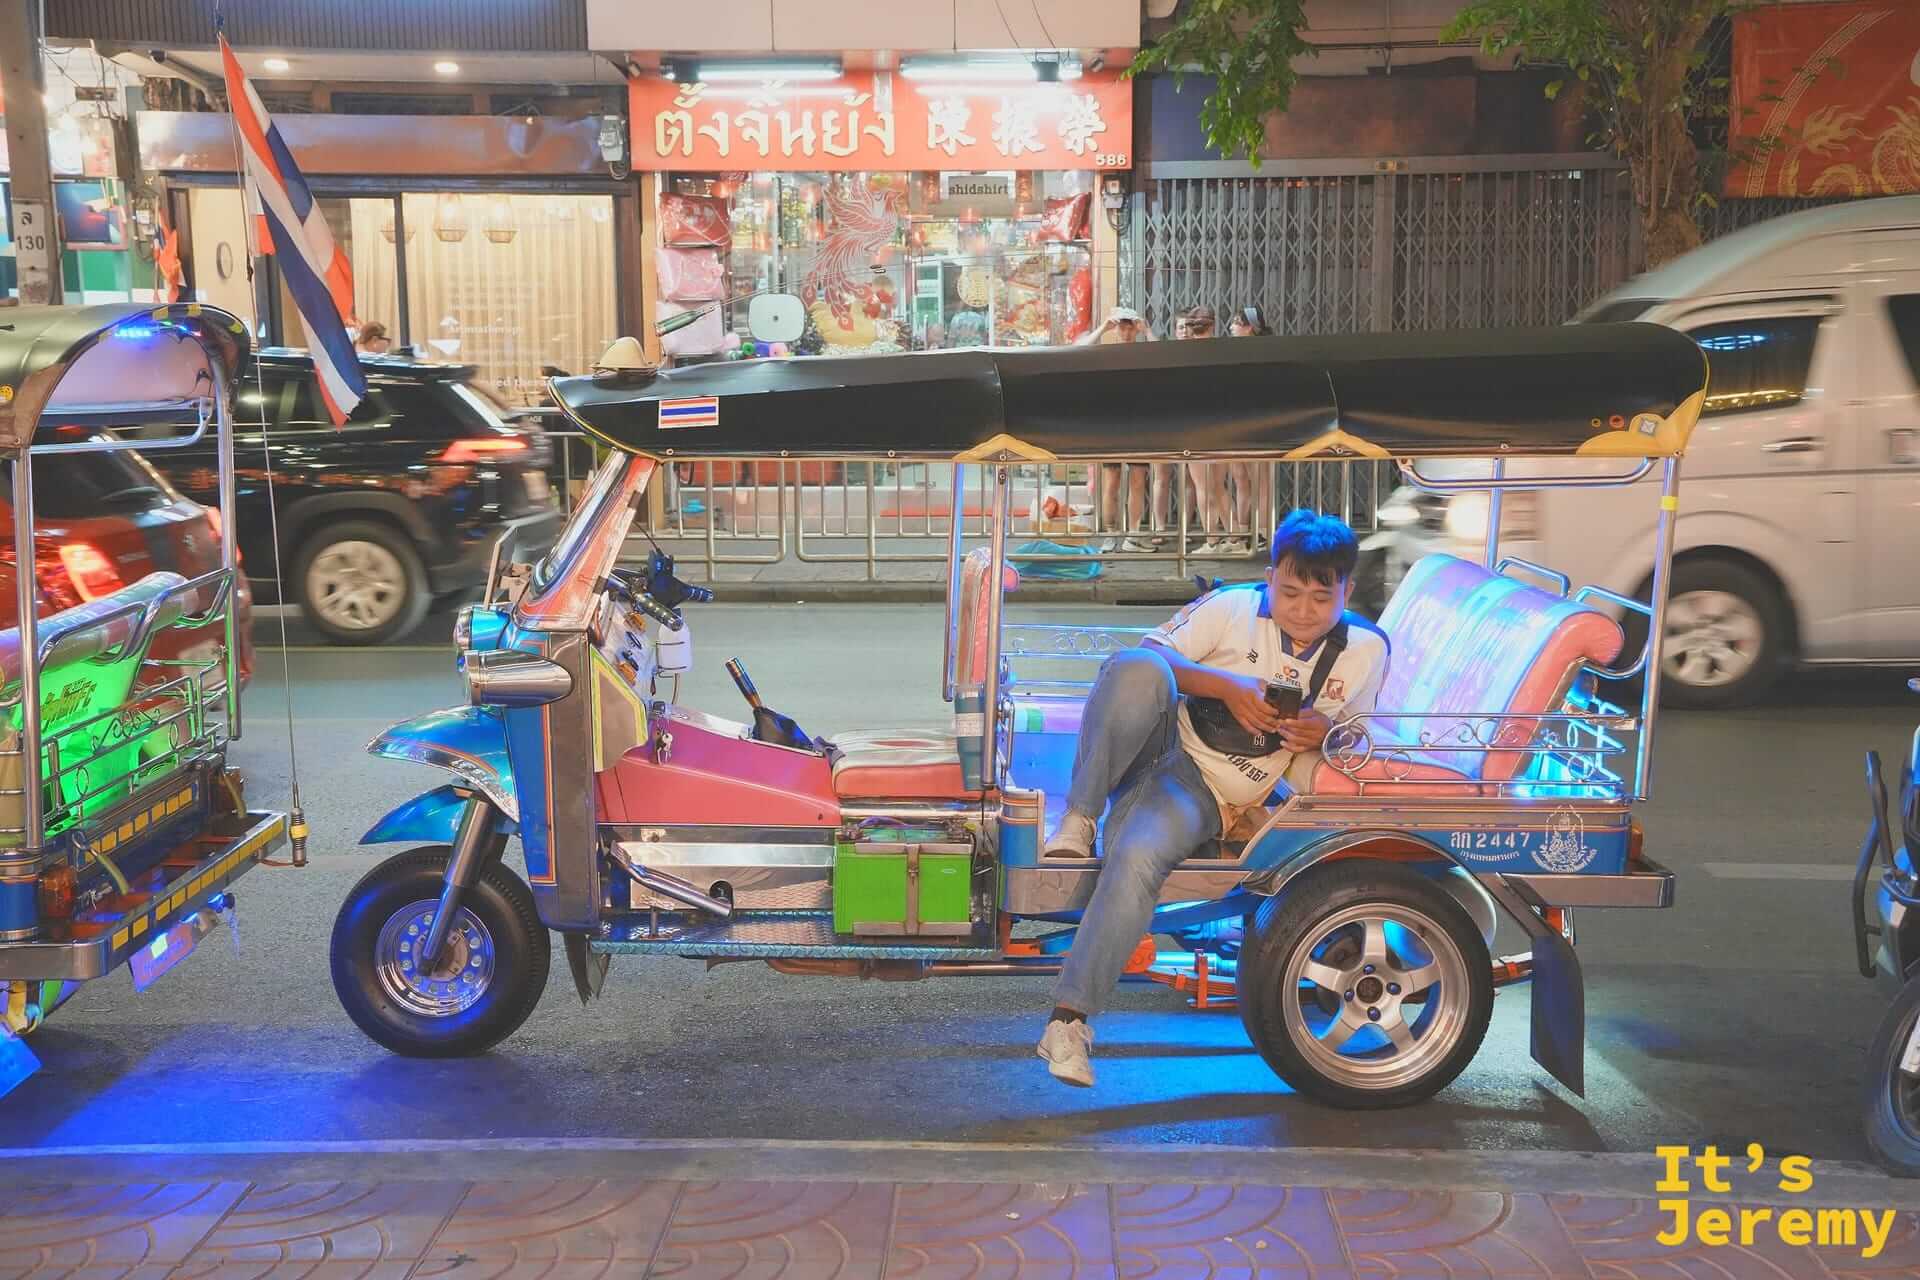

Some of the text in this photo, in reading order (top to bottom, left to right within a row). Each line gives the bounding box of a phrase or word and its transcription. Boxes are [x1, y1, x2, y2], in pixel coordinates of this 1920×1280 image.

[1095, 153, 1127, 166] 586
[949, 182, 1009, 196] shidshirt
[17, 235, 45, 251] 130
[1475, 832, 1531, 849] 2447
